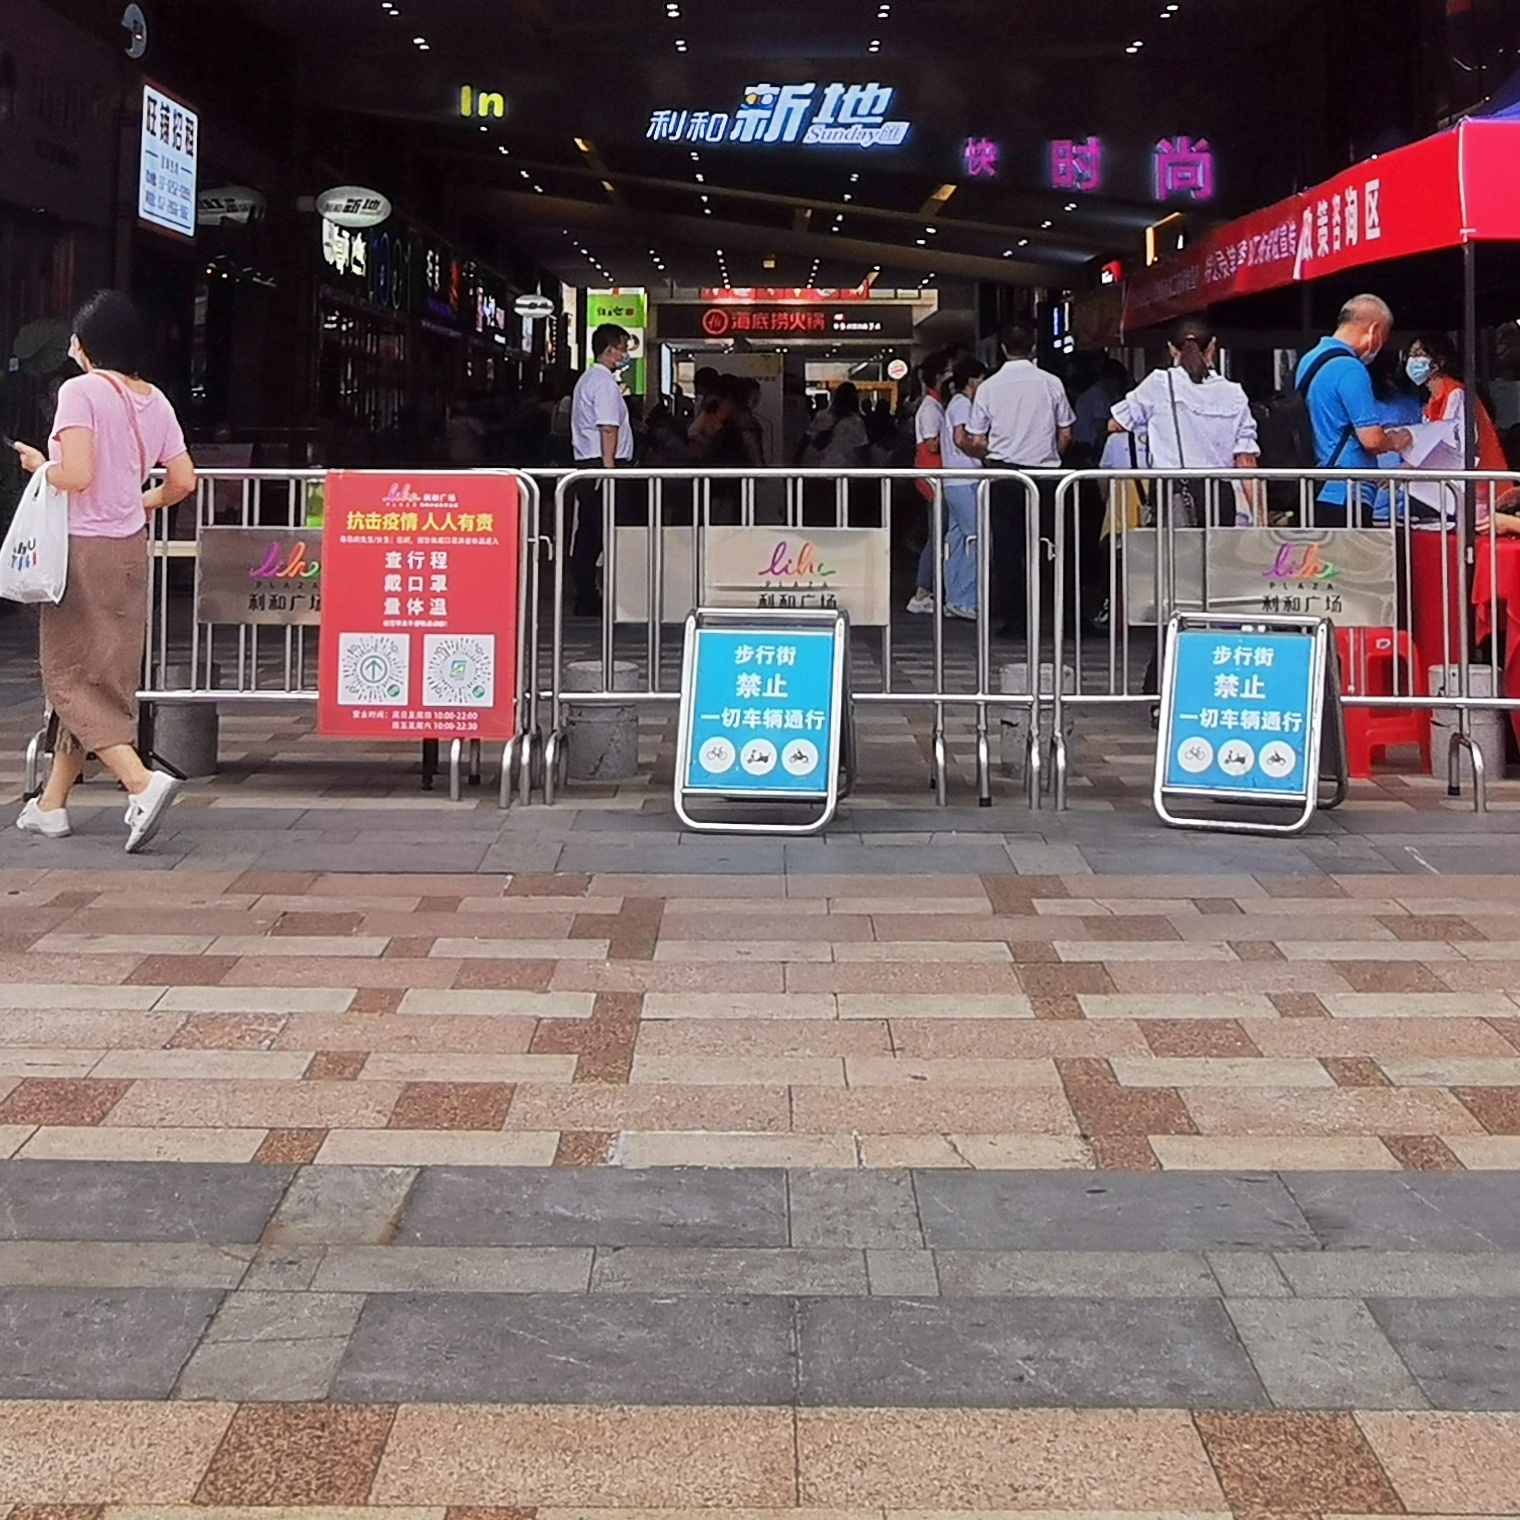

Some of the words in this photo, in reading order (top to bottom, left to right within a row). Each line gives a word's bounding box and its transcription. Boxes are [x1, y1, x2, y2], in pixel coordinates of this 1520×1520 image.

[646, 83, 893, 143] 利和新地
[962, 135, 1216, 201] 快时尚
[346, 510, 419, 531] 抗击疫情
[421, 511, 494, 532] 人人有责
[384, 551, 448, 570] 查行程
[384, 573, 448, 593] 戴口罩
[1269, 582, 1336, 591] PLAZA
[247, 593, 321, 611] 利和广场
[383, 597, 448, 616] 量体温
[758, 593, 837, 609] 利和广场
[1262, 595, 1343, 613] 利和广场
[734, 645, 797, 667] 步行街
[1212, 646, 1275, 668] 步行街
[735, 673, 789, 700] 禁止
[1213, 674, 1266, 700] 禁止
[700, 708, 826, 731] 一切车辆通行
[1178, 708, 1303, 733] 一切车辆通行
